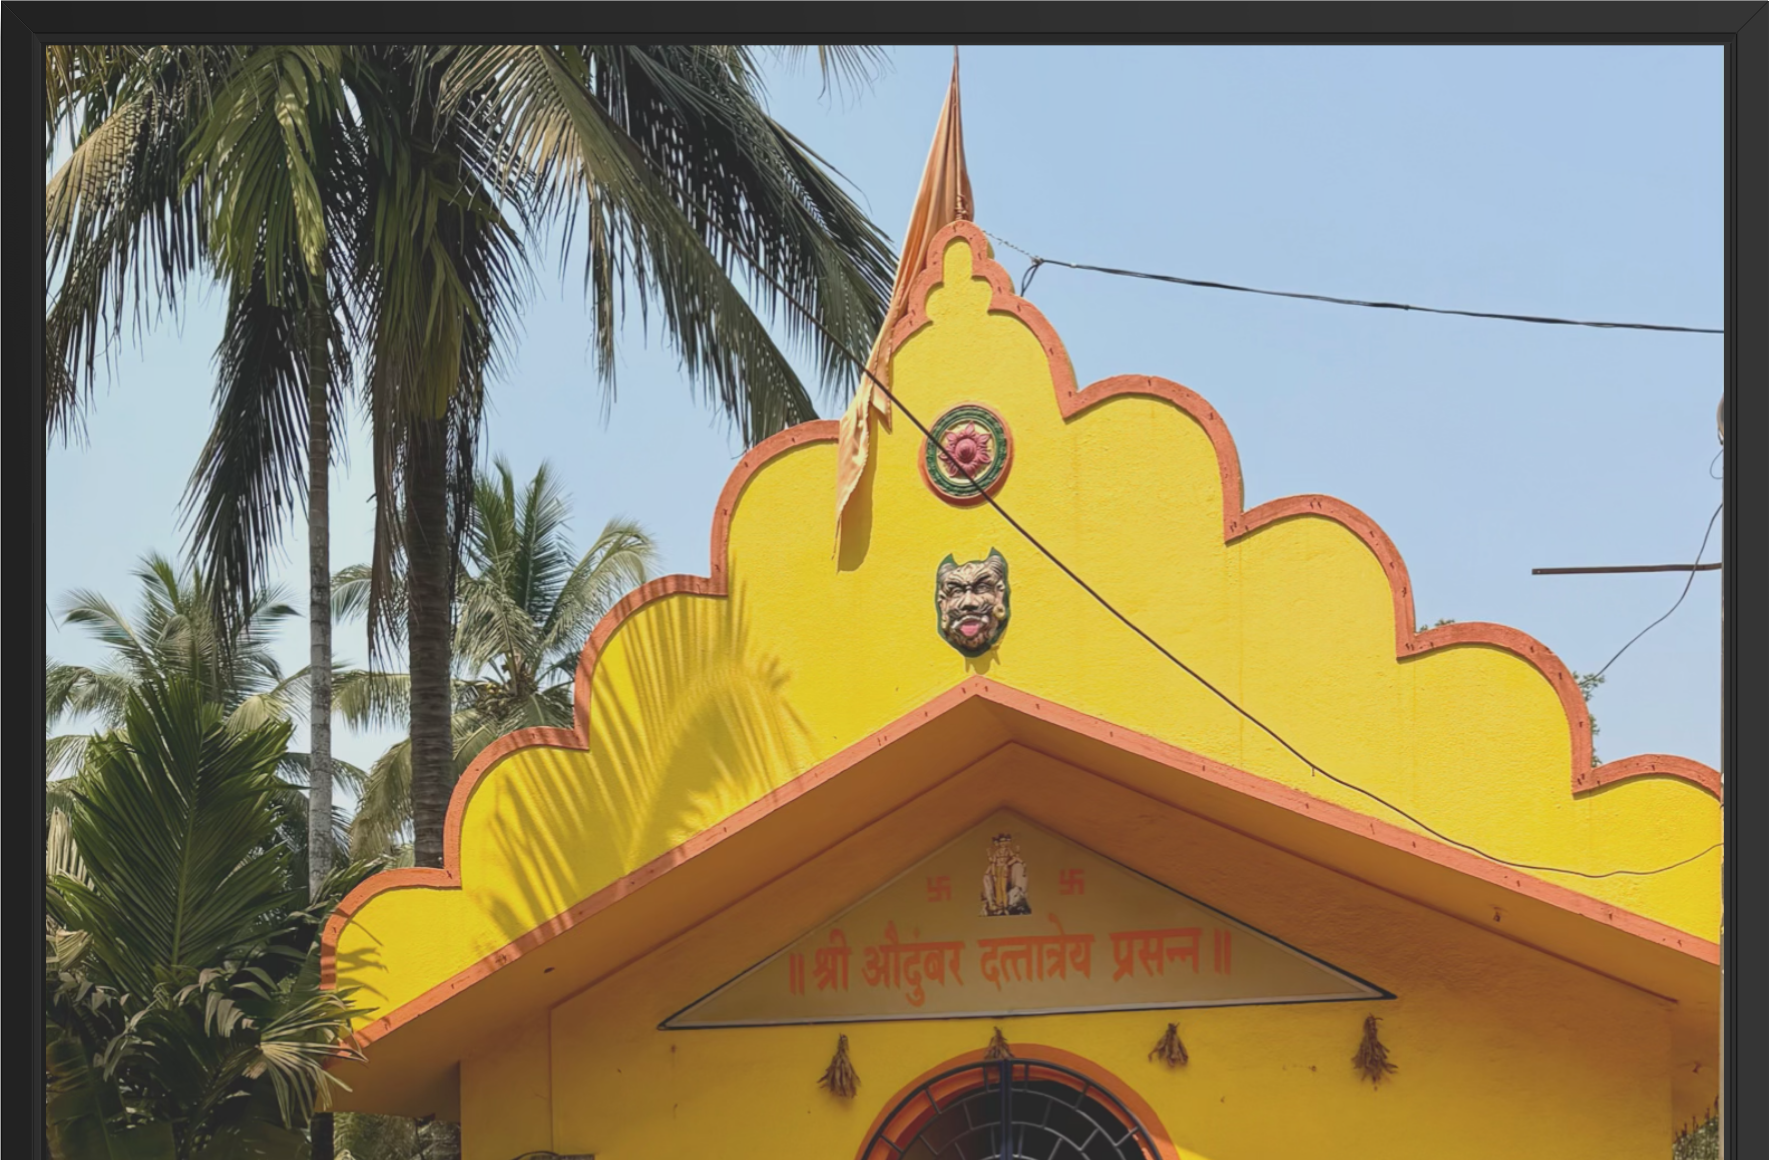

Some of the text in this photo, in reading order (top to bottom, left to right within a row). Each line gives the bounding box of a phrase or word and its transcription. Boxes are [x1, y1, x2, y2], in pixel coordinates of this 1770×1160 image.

[812, 928, 852, 992] श्री
[977, 912, 1096, 992] दत्तात्रेय
[1109, 927, 1203, 983] प्रसन्न
